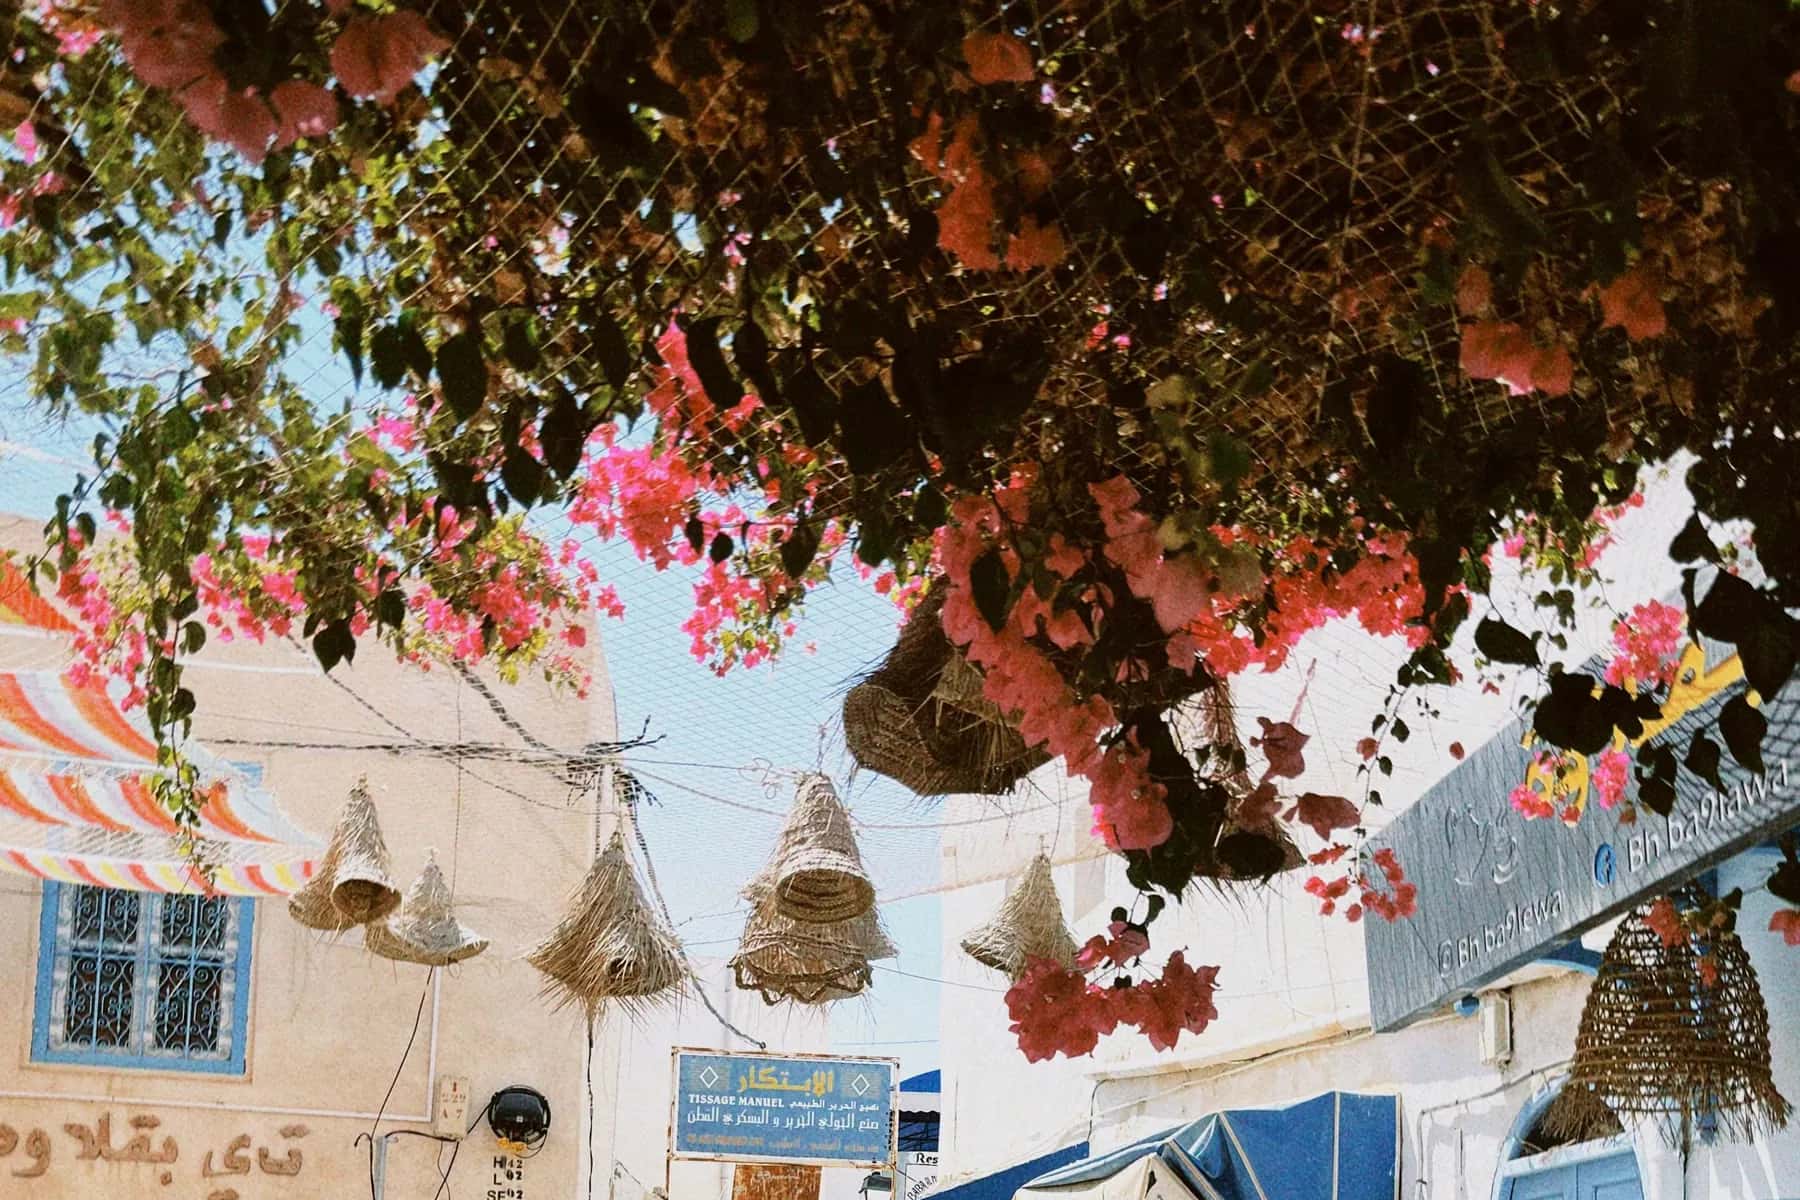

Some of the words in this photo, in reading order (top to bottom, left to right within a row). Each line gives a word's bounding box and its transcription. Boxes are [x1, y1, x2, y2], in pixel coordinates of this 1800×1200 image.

[1457, 933, 1480, 969] Bh
[737, 1065, 835, 1098] الابتكار
[688, 1094, 736, 1105] TISSAGE
[739, 1096, 785, 1109] MANUEL
